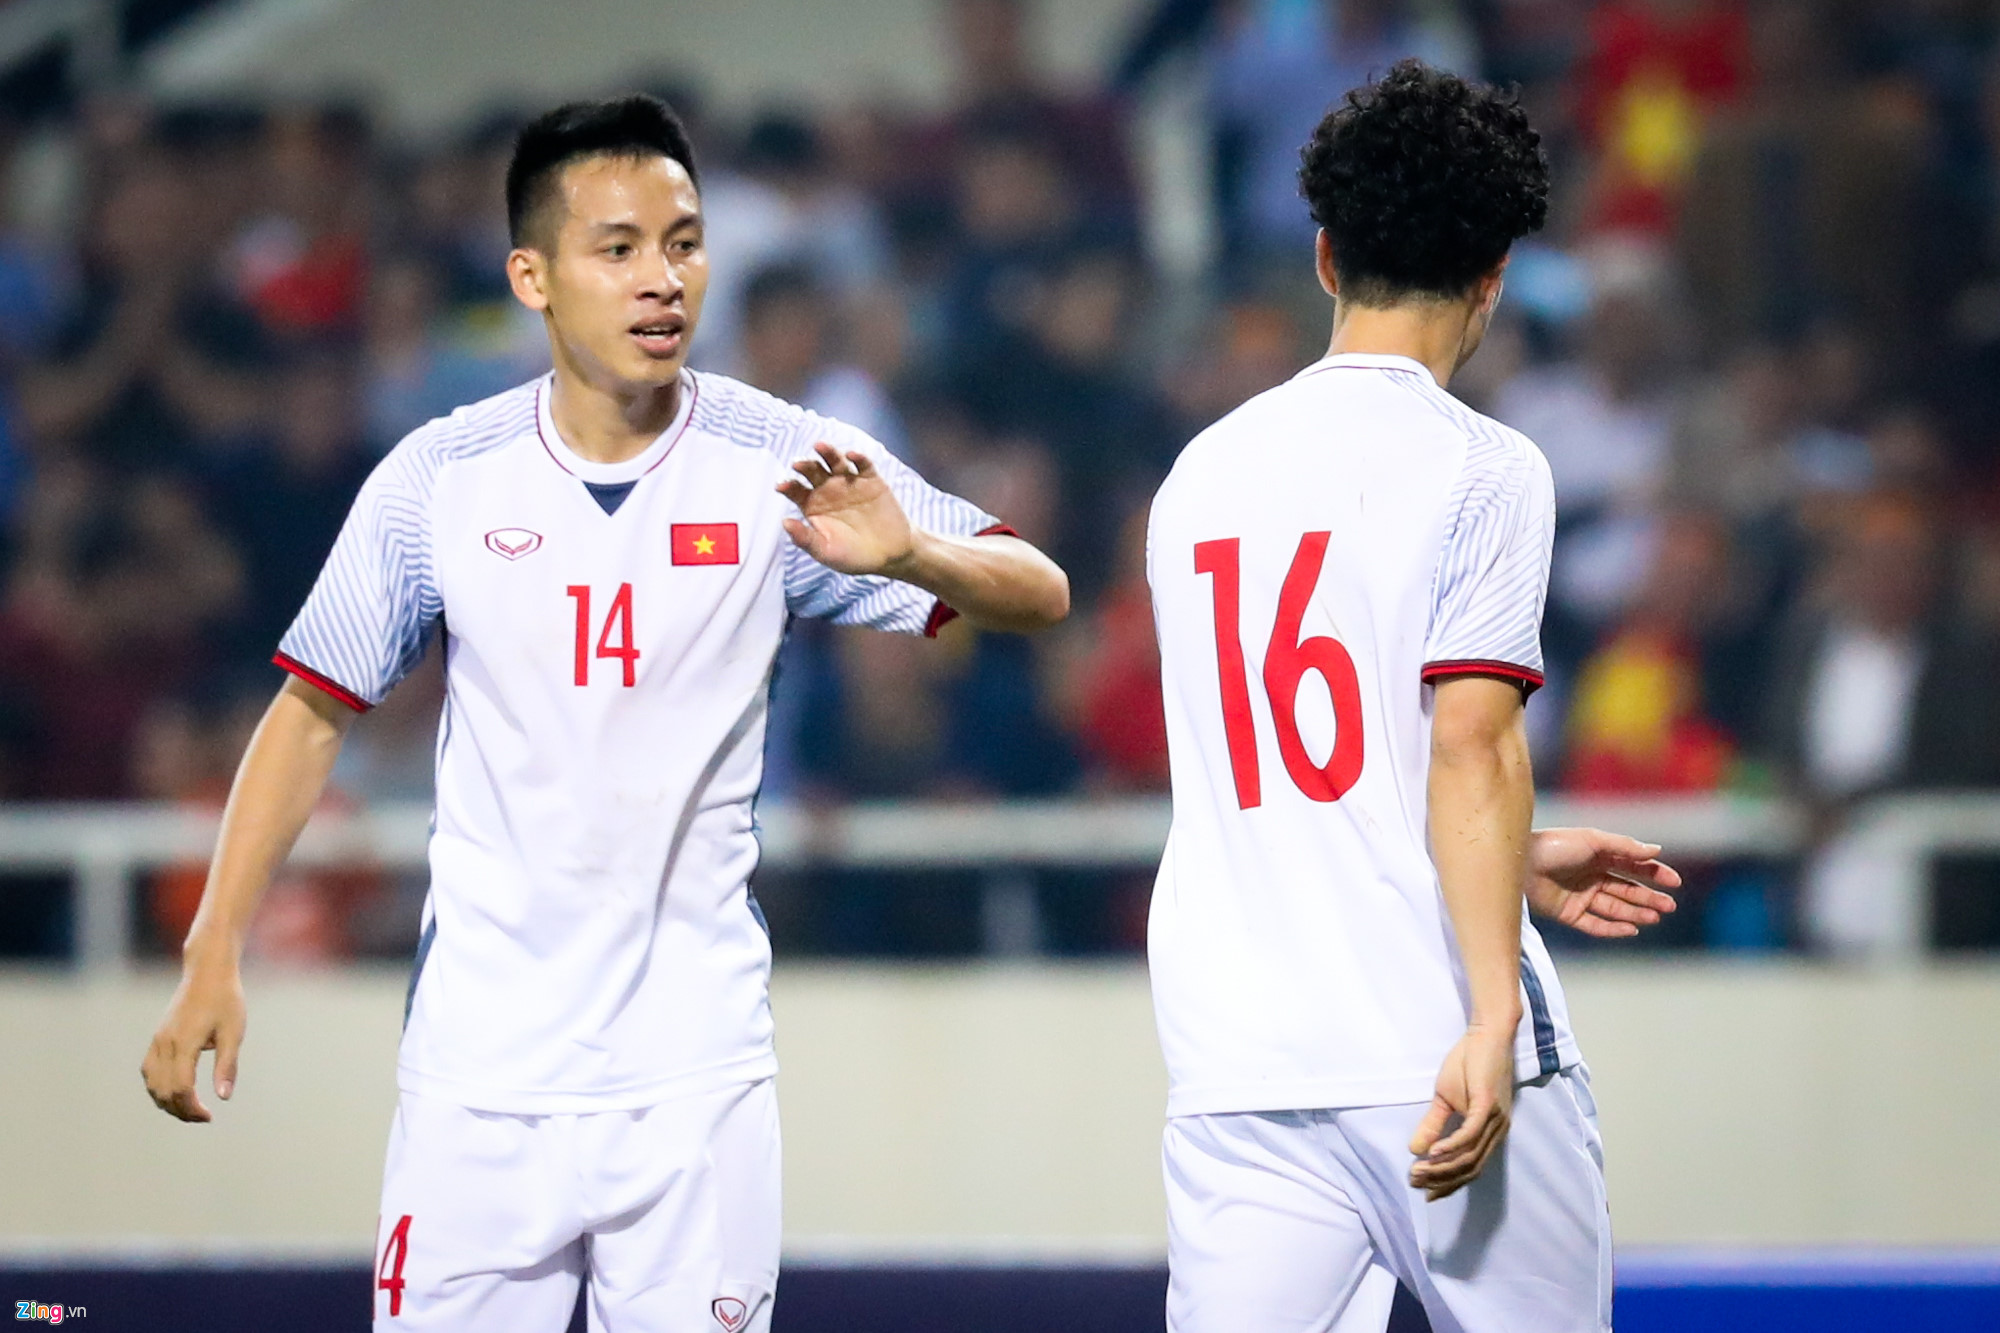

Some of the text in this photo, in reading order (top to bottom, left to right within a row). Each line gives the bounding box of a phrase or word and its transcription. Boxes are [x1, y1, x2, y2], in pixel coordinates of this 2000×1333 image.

[567, 582, 641, 688] 14
[1194, 531, 1365, 809] 16
[372, 1213, 413, 1320] 4
